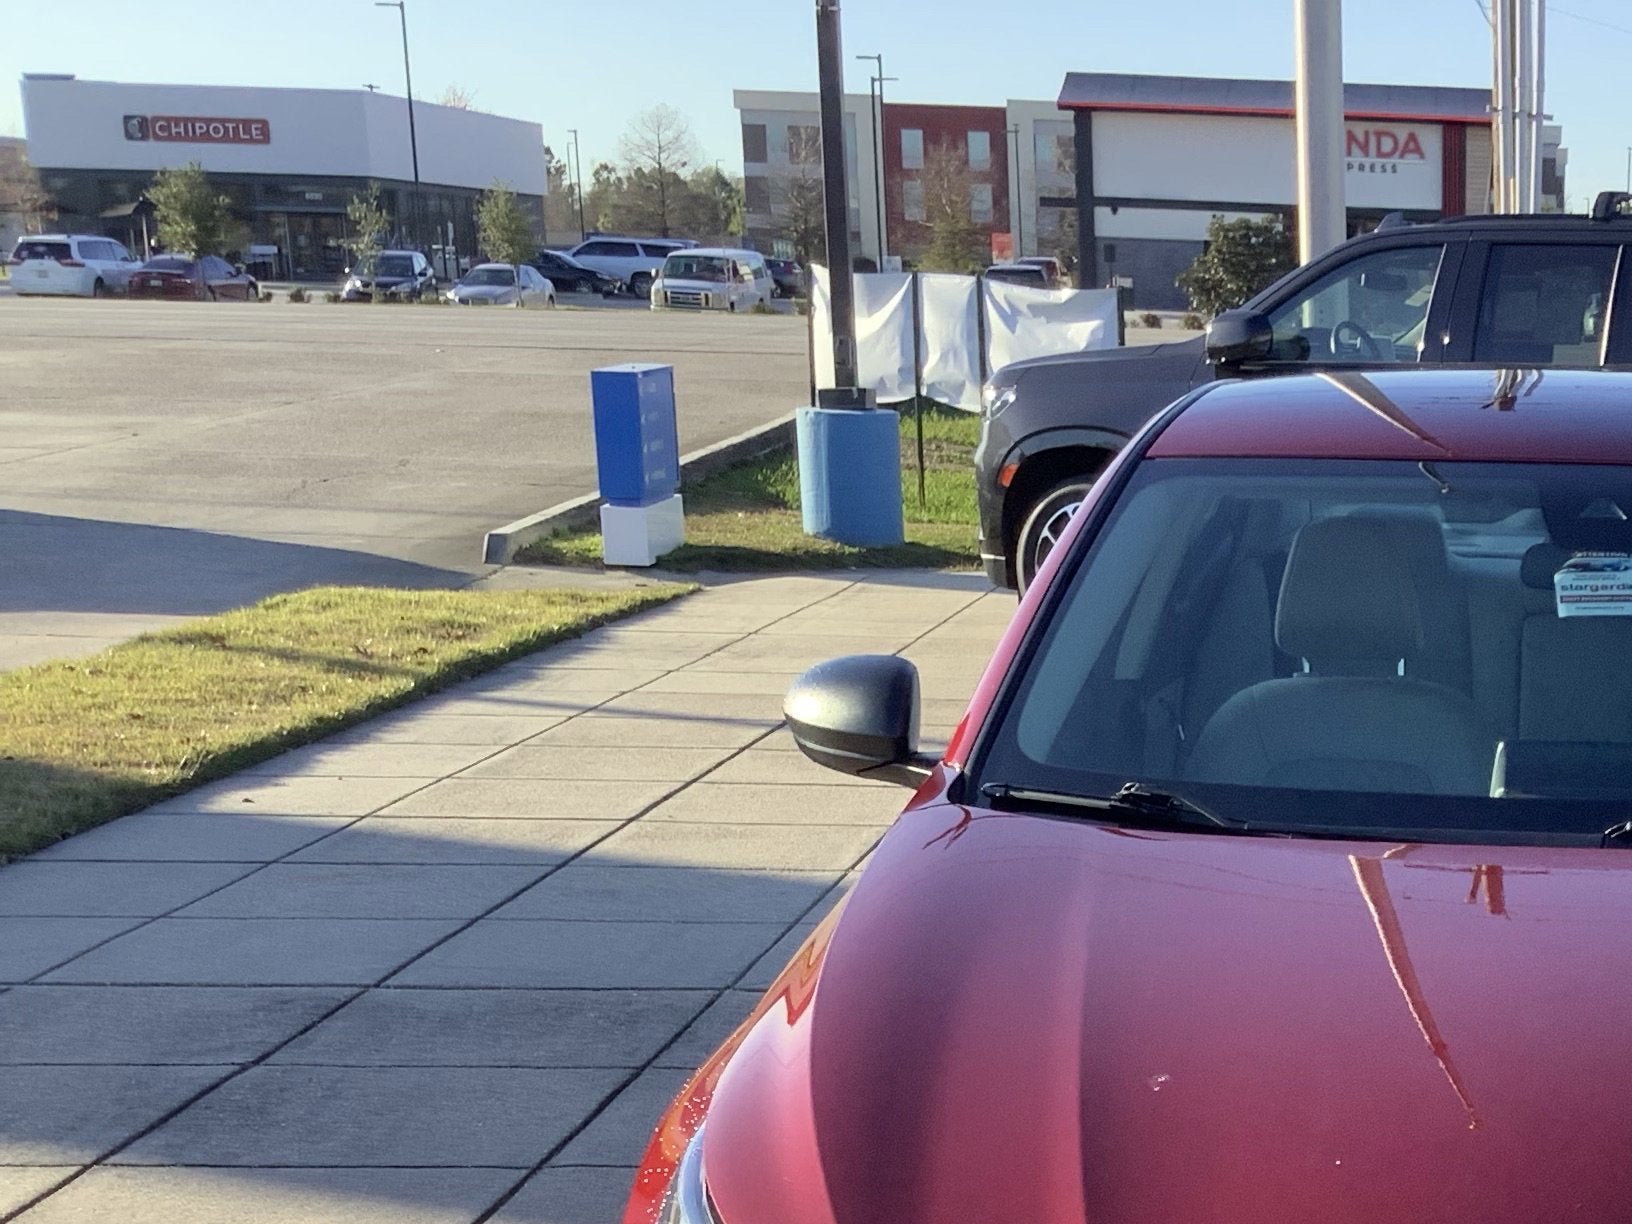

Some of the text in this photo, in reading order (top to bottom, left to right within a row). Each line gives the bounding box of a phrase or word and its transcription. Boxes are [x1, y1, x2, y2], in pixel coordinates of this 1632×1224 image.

[155, 121, 263, 140] CHIPOTLE
[1345, 129, 1426, 160] NDA
[1346, 162, 1398, 173] PRESS
